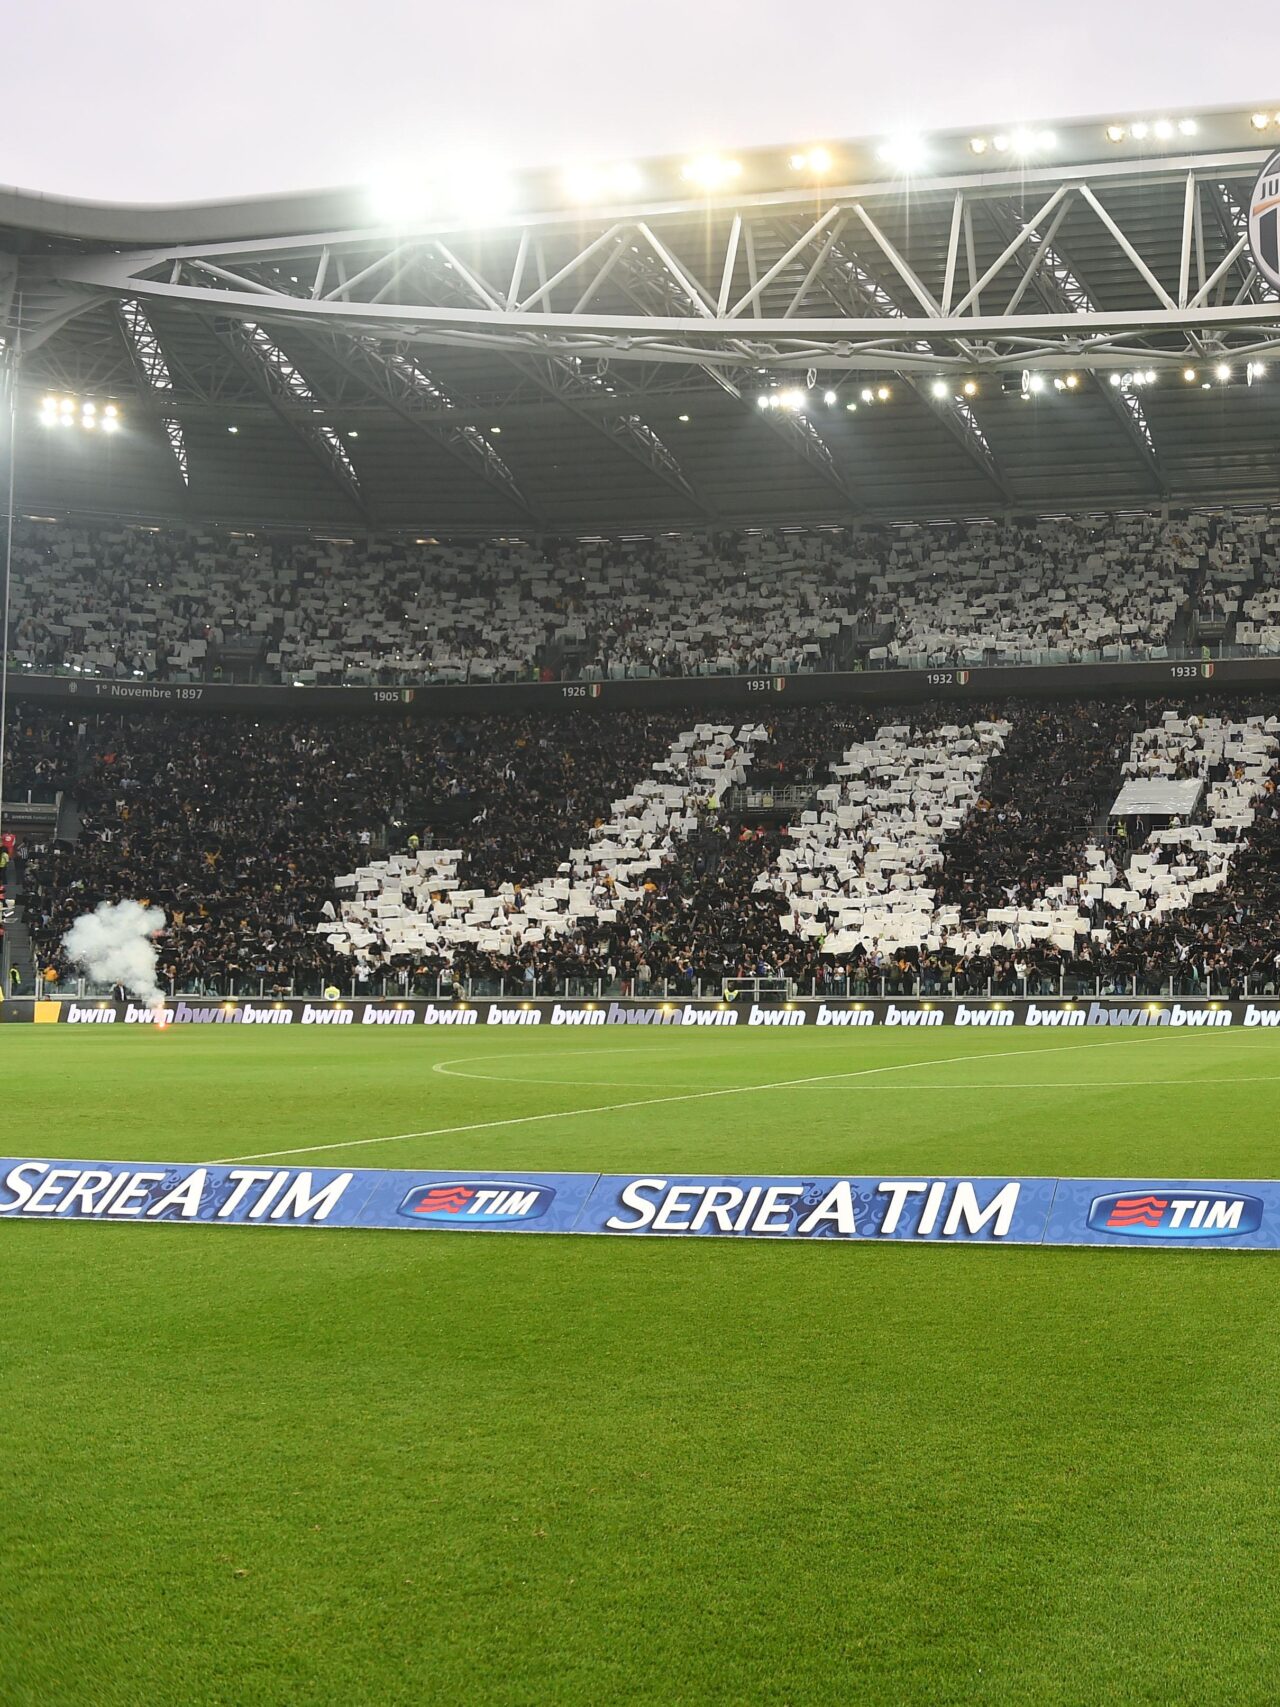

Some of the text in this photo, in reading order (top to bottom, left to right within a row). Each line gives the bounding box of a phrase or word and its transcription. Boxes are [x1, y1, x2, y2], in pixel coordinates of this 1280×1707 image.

[927, 674, 953, 684] 1932
[1170, 666, 1197, 677] 1933
[111, 685, 172, 699] Novembre
[175, 688, 203, 700] 1897
[562, 686, 586, 697] 1926
[746, 680, 771, 691] 1931
[373, 691, 399, 702] 1905
[67, 1003, 116, 1023] bwin
[174, 1002, 243, 1023] bwin
[241, 1003, 293, 1023] bwin
[301, 1003, 353, 1023] bwin
[362, 1003, 415, 1023] bwin
[424, 1003, 477, 1023] bwin
[487, 1003, 541, 1023] bwin
[551, 1003, 606, 1025] bwin
[606, 1002, 683, 1025] bwin
[681, 1003, 738, 1025] bwin
[749, 1003, 805, 1025] bwin
[817, 1003, 874, 1025] bwin
[885, 1003, 944, 1025] bwin
[955, 1003, 1014, 1025] bwin
[1026, 1003, 1085, 1025] bwin
[1086, 1002, 1172, 1025] bwin
[1170, 1003, 1232, 1025] bwin
[0, 1161, 354, 1220] SERIE A TIM
[467, 1190, 541, 1216] TIM
[606, 1178, 1021, 1236] SERIE A TIM
[1169, 1200, 1246, 1229] TIM
